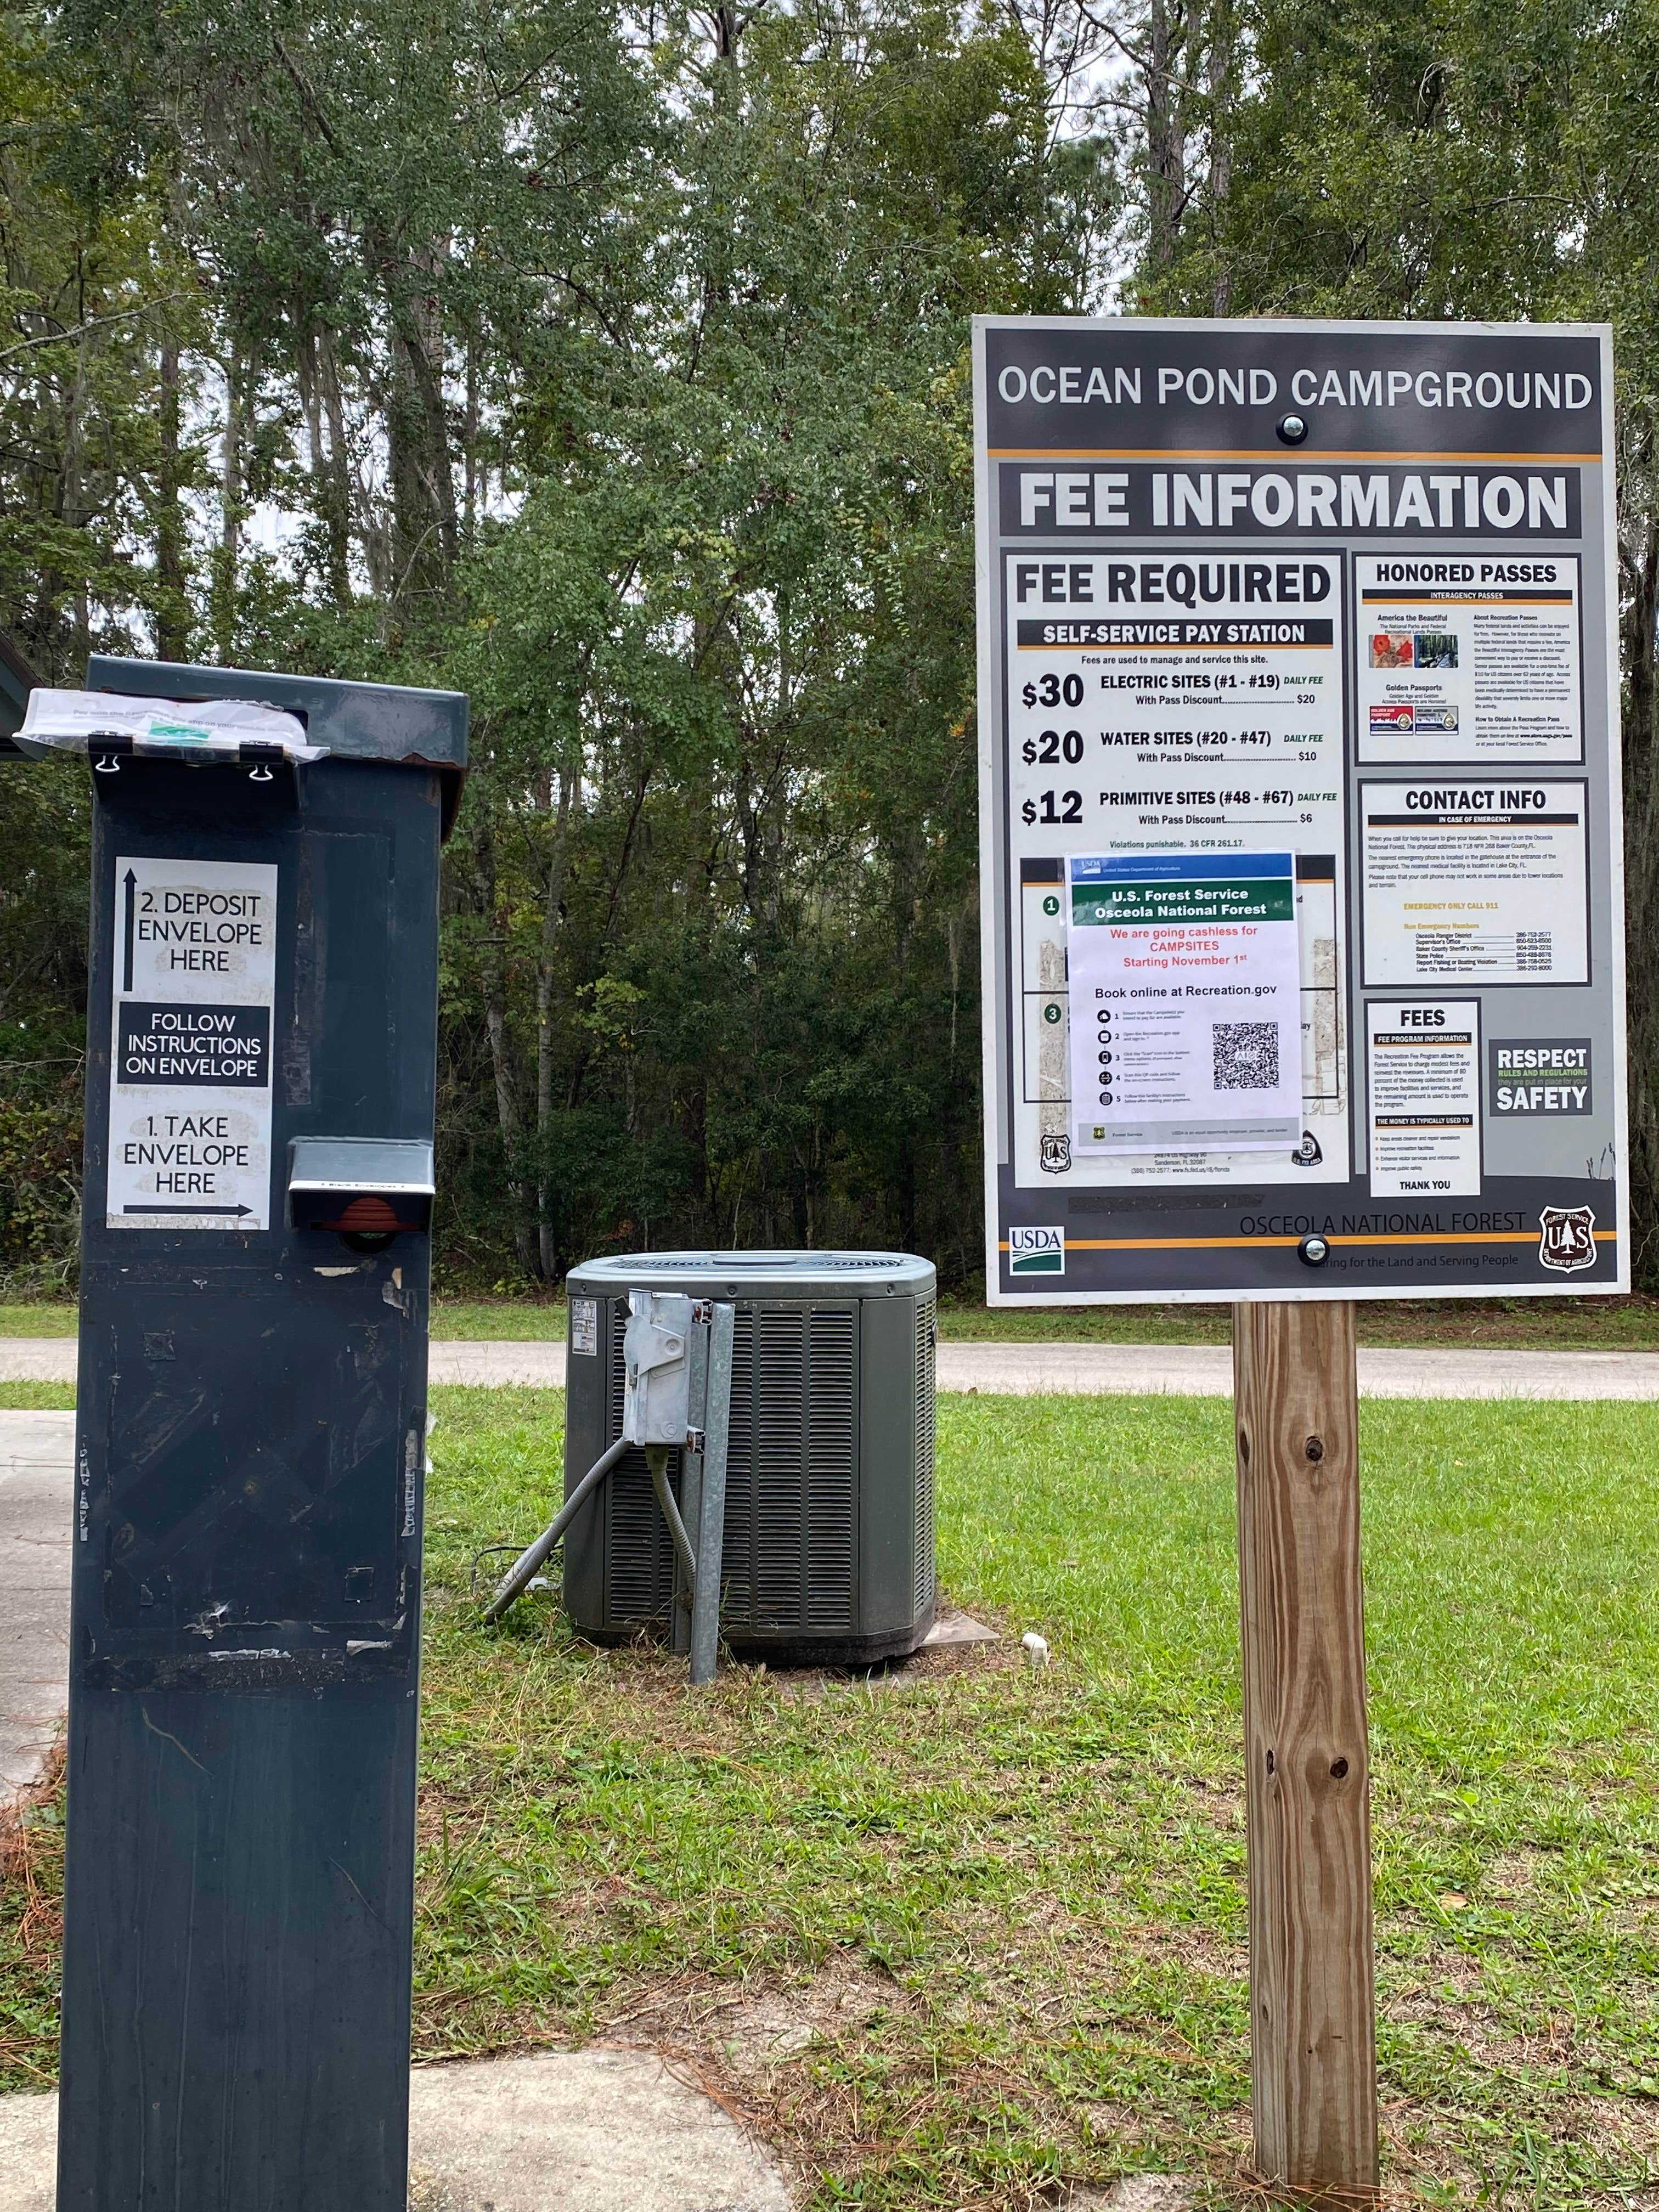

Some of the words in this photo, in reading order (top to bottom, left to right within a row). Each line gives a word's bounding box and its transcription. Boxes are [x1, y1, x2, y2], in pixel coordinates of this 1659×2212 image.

[998, 366, 1141, 403] OCEAN
[1159, 368, 1277, 404] POND
[1292, 370, 1592, 408] CAMPGROUND
[1020, 473, 1129, 526] FEE
[1153, 474, 1566, 528] INFORMATION
[1377, 564, 1474, 582] HONORED
[1481, 565, 1556, 582] PASSES
[1017, 564, 1093, 602] FEE
[1108, 564, 1330, 609] REQUIRED
[1043, 625, 1180, 642] SELF-SERVICE
[1186, 625, 1221, 642] PAY
[1227, 625, 1304, 642] STATION
[1119, 656, 1137, 664] used
[1150, 656, 1183, 665] manage
[1203, 655, 1231, 663] service
[1102, 675, 1167, 688] ELECTRIC
[1172, 675, 1210, 688] SITES
[1215, 675, 1237, 690] (#1
[1249, 675, 1279, 690] #19)
[1023, 674, 1084, 709] $30
[1136, 696, 1156, 704] With
[1159, 696, 1180, 704] Pass
[1297, 695, 1314, 704] $20
[1101, 732, 1149, 745] WATER
[1154, 732, 1193, 745] SITES
[1197, 732, 1228, 747] (#20
[1240, 731, 1271, 747] #47)
[1022, 731, 1084, 766] $20
[1137, 753, 1158, 762] With
[1161, 753, 1182, 761] Pass
[1299, 752, 1316, 761] $10
[1100, 792, 1173, 805] PRIMITIVE
[1176, 791, 1216, 804] SITES
[1220, 791, 1250, 806] (#48
[1262, 791, 1293, 806] #67)
[1406, 791, 1494, 809] CONTACT
[1500, 791, 1545, 809] INFO
[1022, 791, 1082, 826] $12
[1139, 815, 1159, 824] With
[1162, 815, 1183, 824] Pass
[1300, 814, 1312, 823] $6
[1146, 840, 1186, 849] punishable.
[141, 892, 157, 912] 2.
[165, 892, 261, 916] DEPOSIT
[1112, 891, 1141, 902] U.S.
[1146, 890, 1190, 901] Forest
[1195, 889, 1248, 900] Service
[1047, 899, 1056, 911] 1
[1095, 906, 1153, 918] Osceola
[1158, 905, 1216, 916] National
[1222, 904, 1266, 915] Forest
[139, 919, 262, 945] ENVELOPE
[1110, 929, 1128, 938] We
[1153, 928, 1184, 940] going
[1189, 927, 1238, 936] cashless
[1242, 926, 1257, 935] for
[1150, 941, 1219, 951] CAMPSITES
[171, 949, 229, 971] HERE
[1124, 958, 1167, 968] Starting
[1172, 956, 1230, 966] November
[1096, 988, 1126, 998] Book
[1131, 988, 1167, 997] online
[1171, 987, 1182, 996] at
[1186, 985, 1277, 996] Recreation.gov
[152, 1013, 235, 1032] FOLLOW
[1048, 1008, 1058, 1020] 3
[1401, 1009, 1445, 1026] FEES
[129, 1035, 261, 1054] INSTRUCTIONS
[126, 1057, 155, 1074] ON
[160, 1058, 257, 1076] ENVELOPE
[1498, 1049, 1586, 1068] RESPECT
[1498, 1078, 1511, 1087] they
[1525, 1079, 1537, 1087] put
[1545, 1078, 1563, 1086] place
[1564, 1077, 1573, 1086] for
[1497, 1086, 1588, 1110] SAFETY
[147, 1116, 157, 1136] 1.
[165, 1116, 228, 1137] TAKE
[125, 1143, 248, 1166] ENVELOPE
[156, 1172, 215, 1193] HERE
[1400, 1181, 1430, 1189] THANK
[1432, 1181, 1450, 1189] YOU
[1240, 1216, 1336, 1234] OSCEOLA
[1342, 1214, 1446, 1233] NATIONAL
[1452, 1212, 1526, 1232] FOREST
[1546, 1214, 1566, 1226] FOREST
[1567, 1213, 1589, 1224] SERVICE
[1012, 1230, 1061, 1249] USDA
[1350, 1257, 1365, 1267] for
[1367, 1257, 1385, 1267] the
[1388, 1256, 1413, 1267] Land
[1417, 1255, 1436, 1266] and
[1440, 1255, 1479, 1268] Serving
[1482, 1254, 1518, 1267] People
